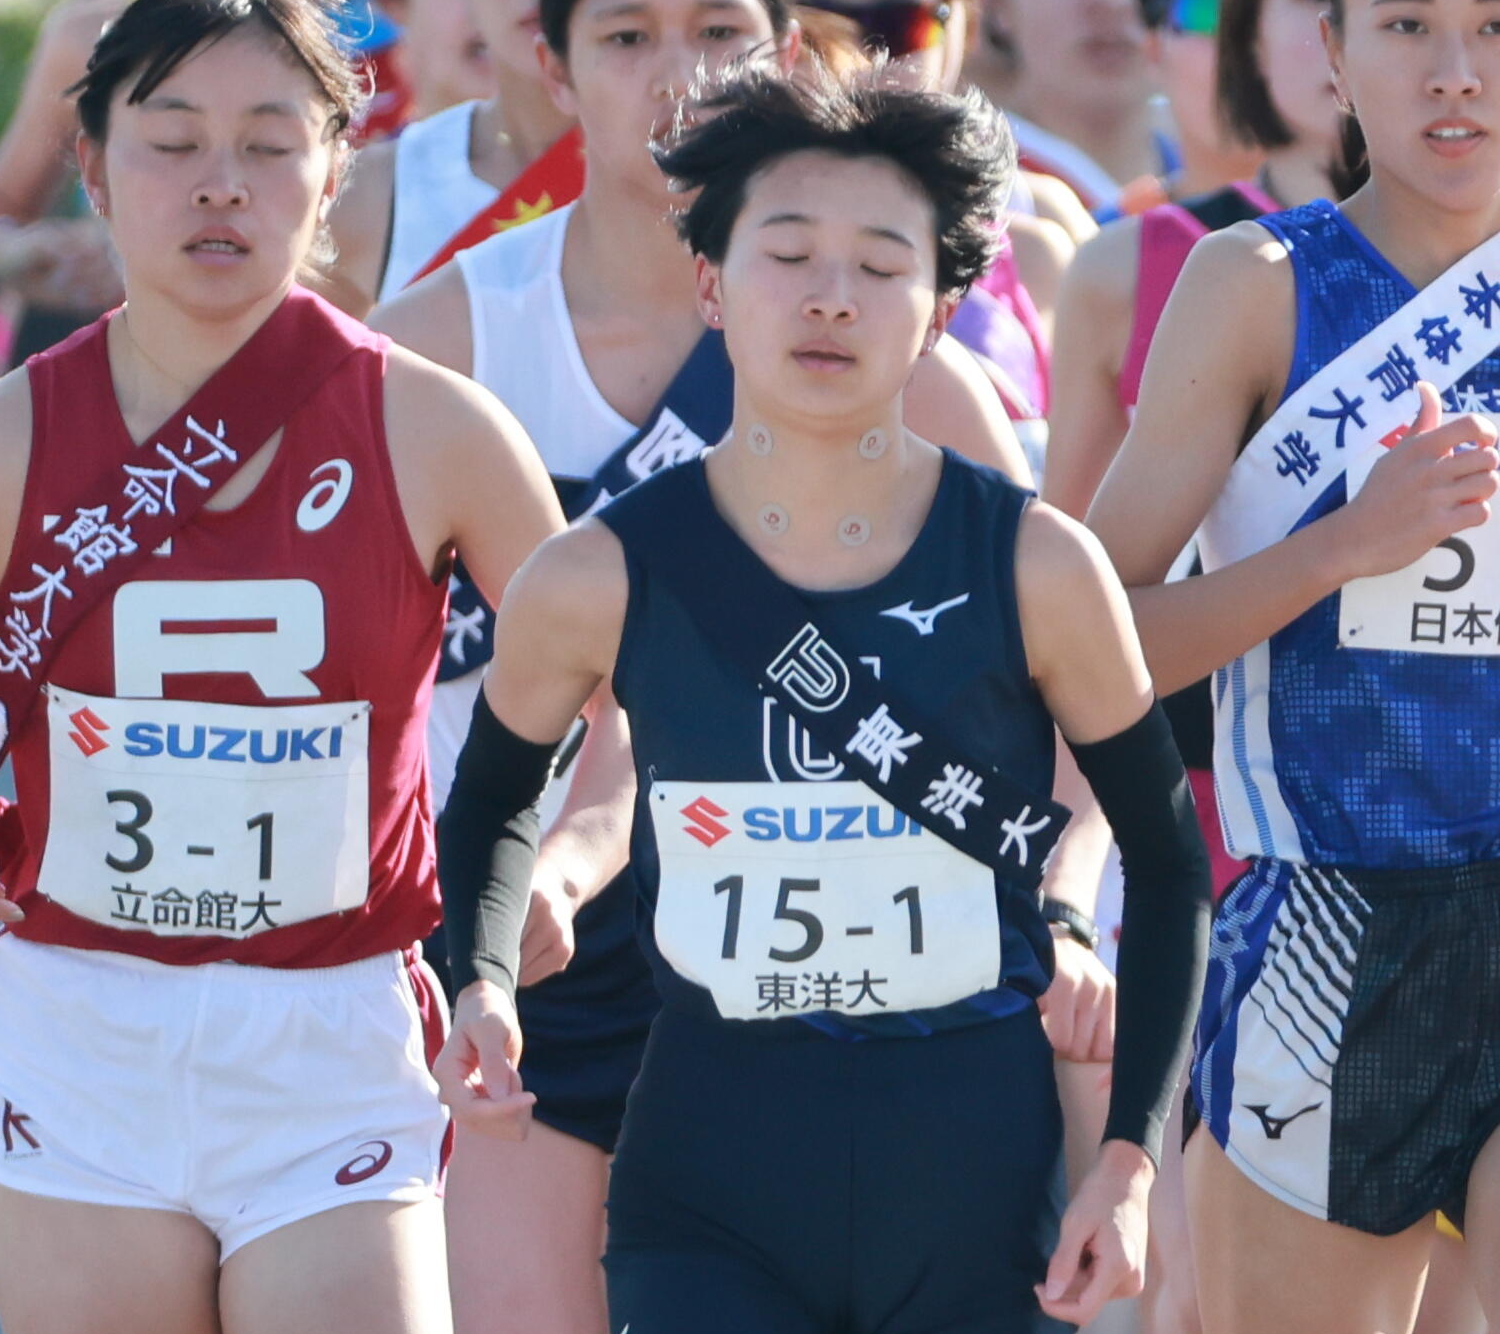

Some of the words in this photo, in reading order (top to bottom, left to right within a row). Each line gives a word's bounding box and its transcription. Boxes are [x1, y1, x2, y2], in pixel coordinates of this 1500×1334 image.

[123, 722, 345, 763] SUZUKI
[844, 703, 1052, 867] 東洋大
[104, 788, 277, 880] 3-1
[743, 804, 925, 842] SUZU
[110, 882, 283, 931] 立命館大
[713, 874, 926, 963] 15-1
[754, 969, 890, 1013] 東洋大
